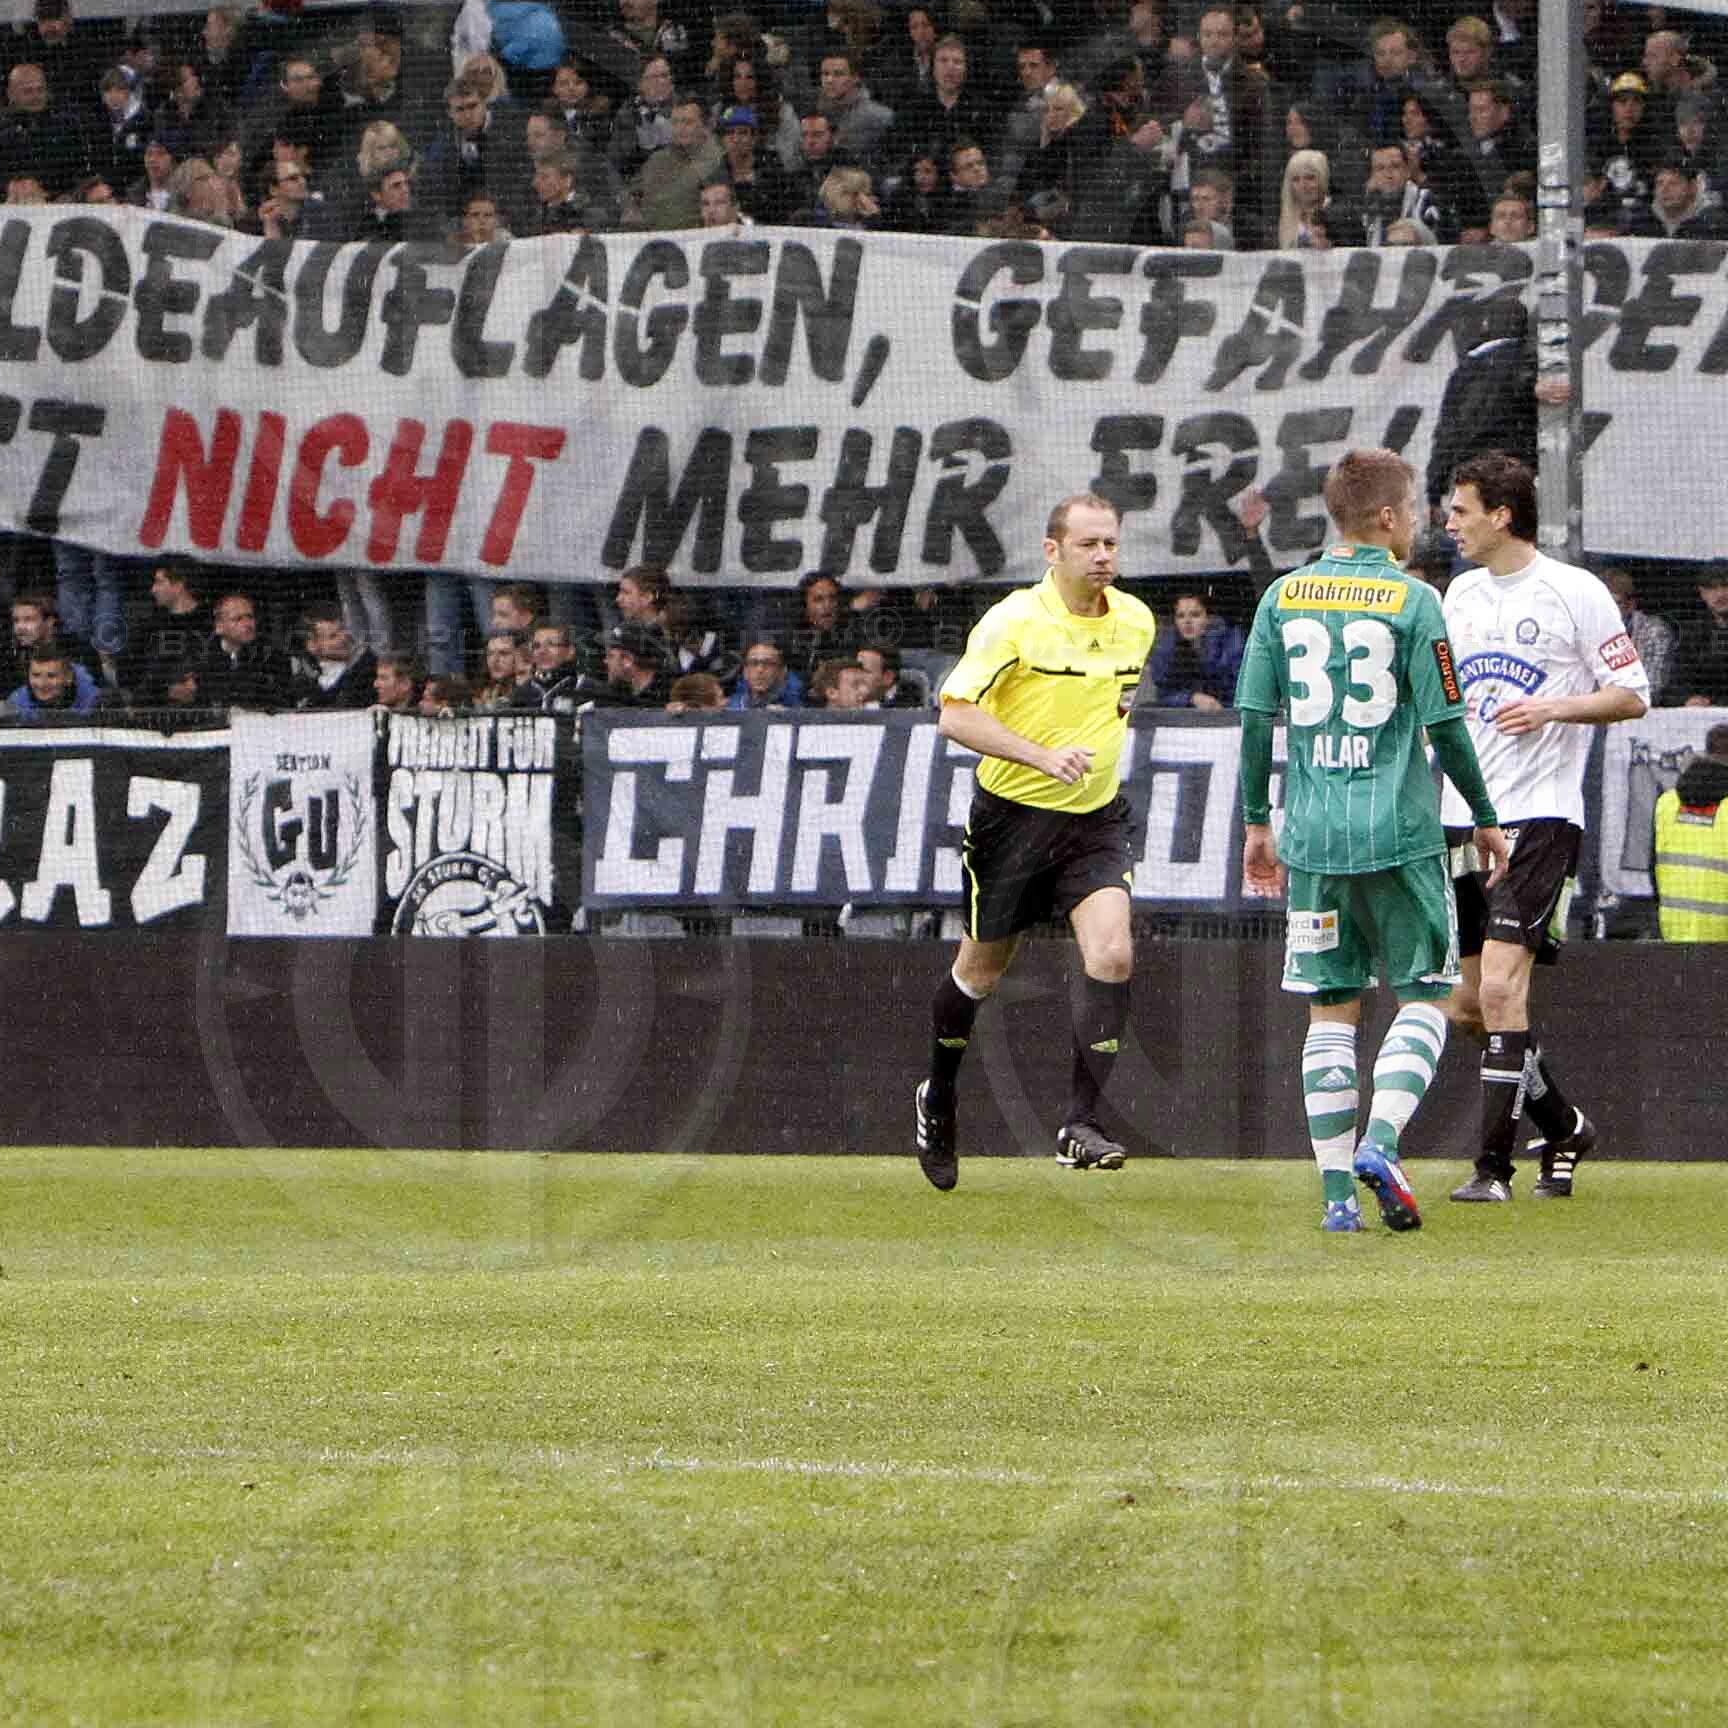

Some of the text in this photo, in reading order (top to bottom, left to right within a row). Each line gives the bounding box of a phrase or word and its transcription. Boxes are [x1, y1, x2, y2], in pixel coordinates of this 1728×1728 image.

[137, 405, 567, 567] NICHT
[601, 416, 1014, 577] MEHR
[1283, 580, 1396, 606] Ottakringer
[1281, 617, 1398, 728] 33
[1436, 641, 1462, 703] Orange
[1312, 735, 1370, 769] ALAR
[385, 768, 555, 909] STURM
